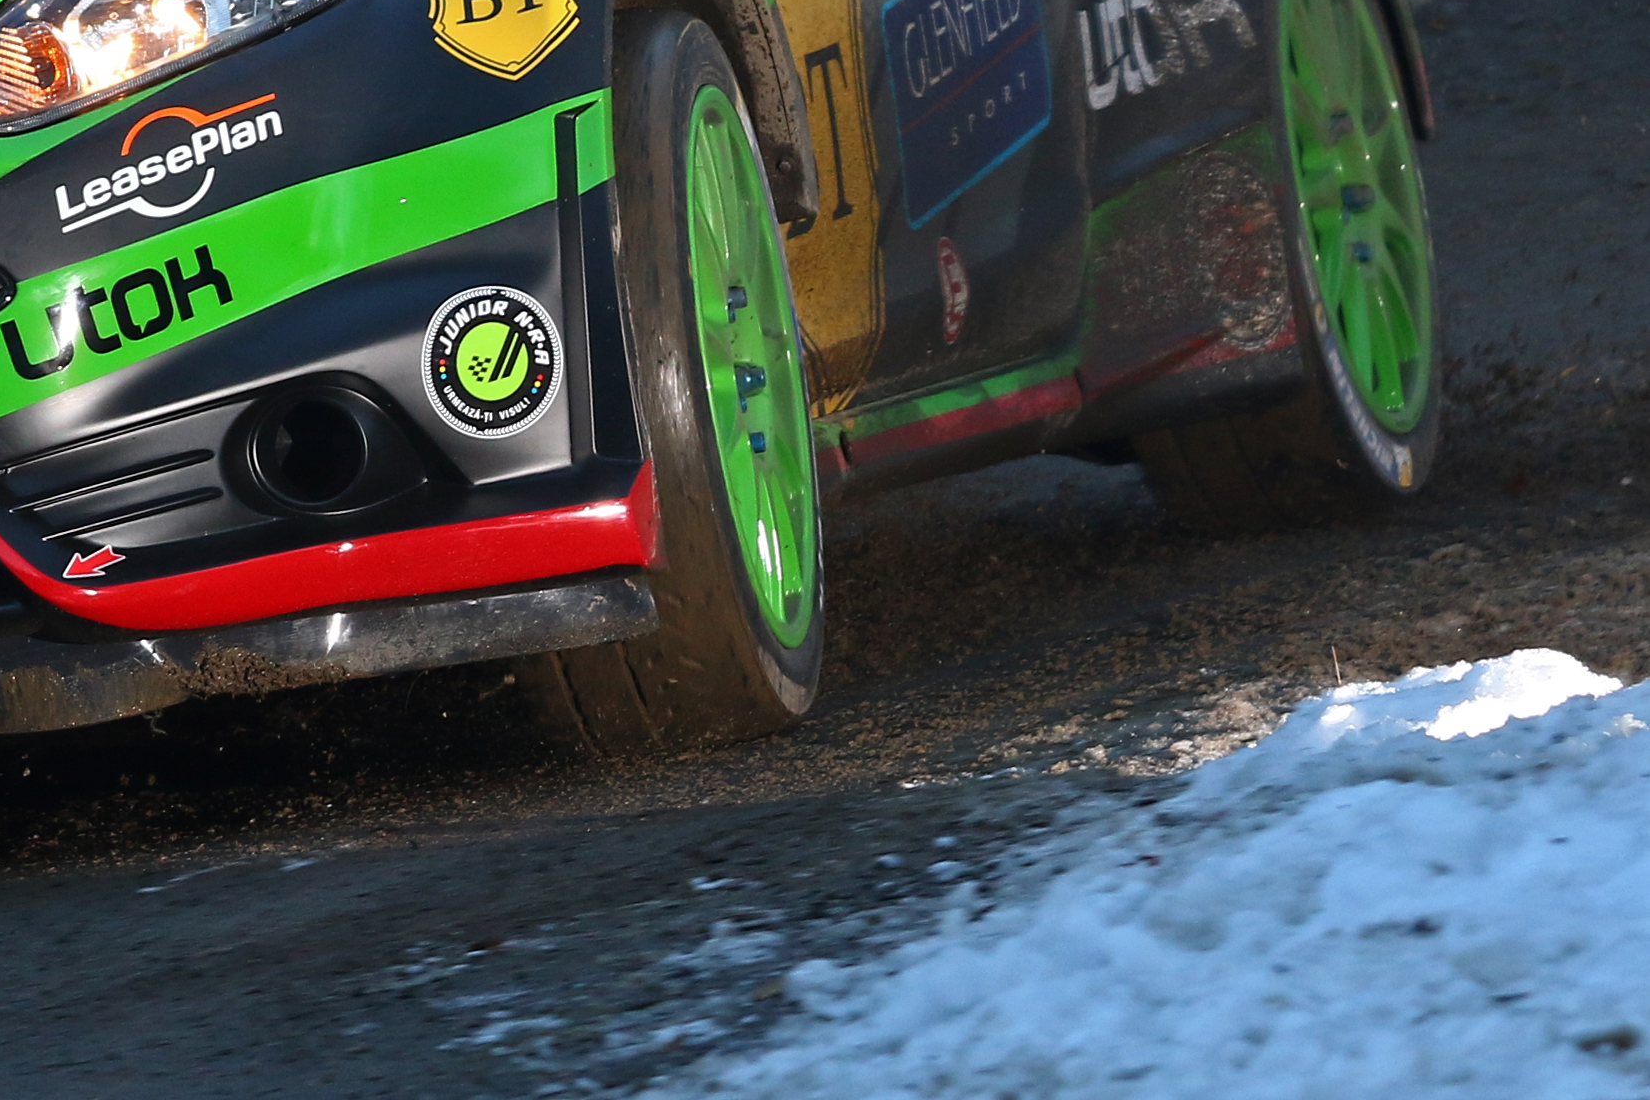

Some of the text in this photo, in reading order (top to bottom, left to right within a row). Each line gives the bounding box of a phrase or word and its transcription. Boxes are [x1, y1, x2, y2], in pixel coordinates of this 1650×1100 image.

[787, 42, 853, 240] T
[951, 71, 1027, 145] SPORT
[56, 107, 283, 219] LeasePlan
[438, 299, 509, 356] JUNIOR
